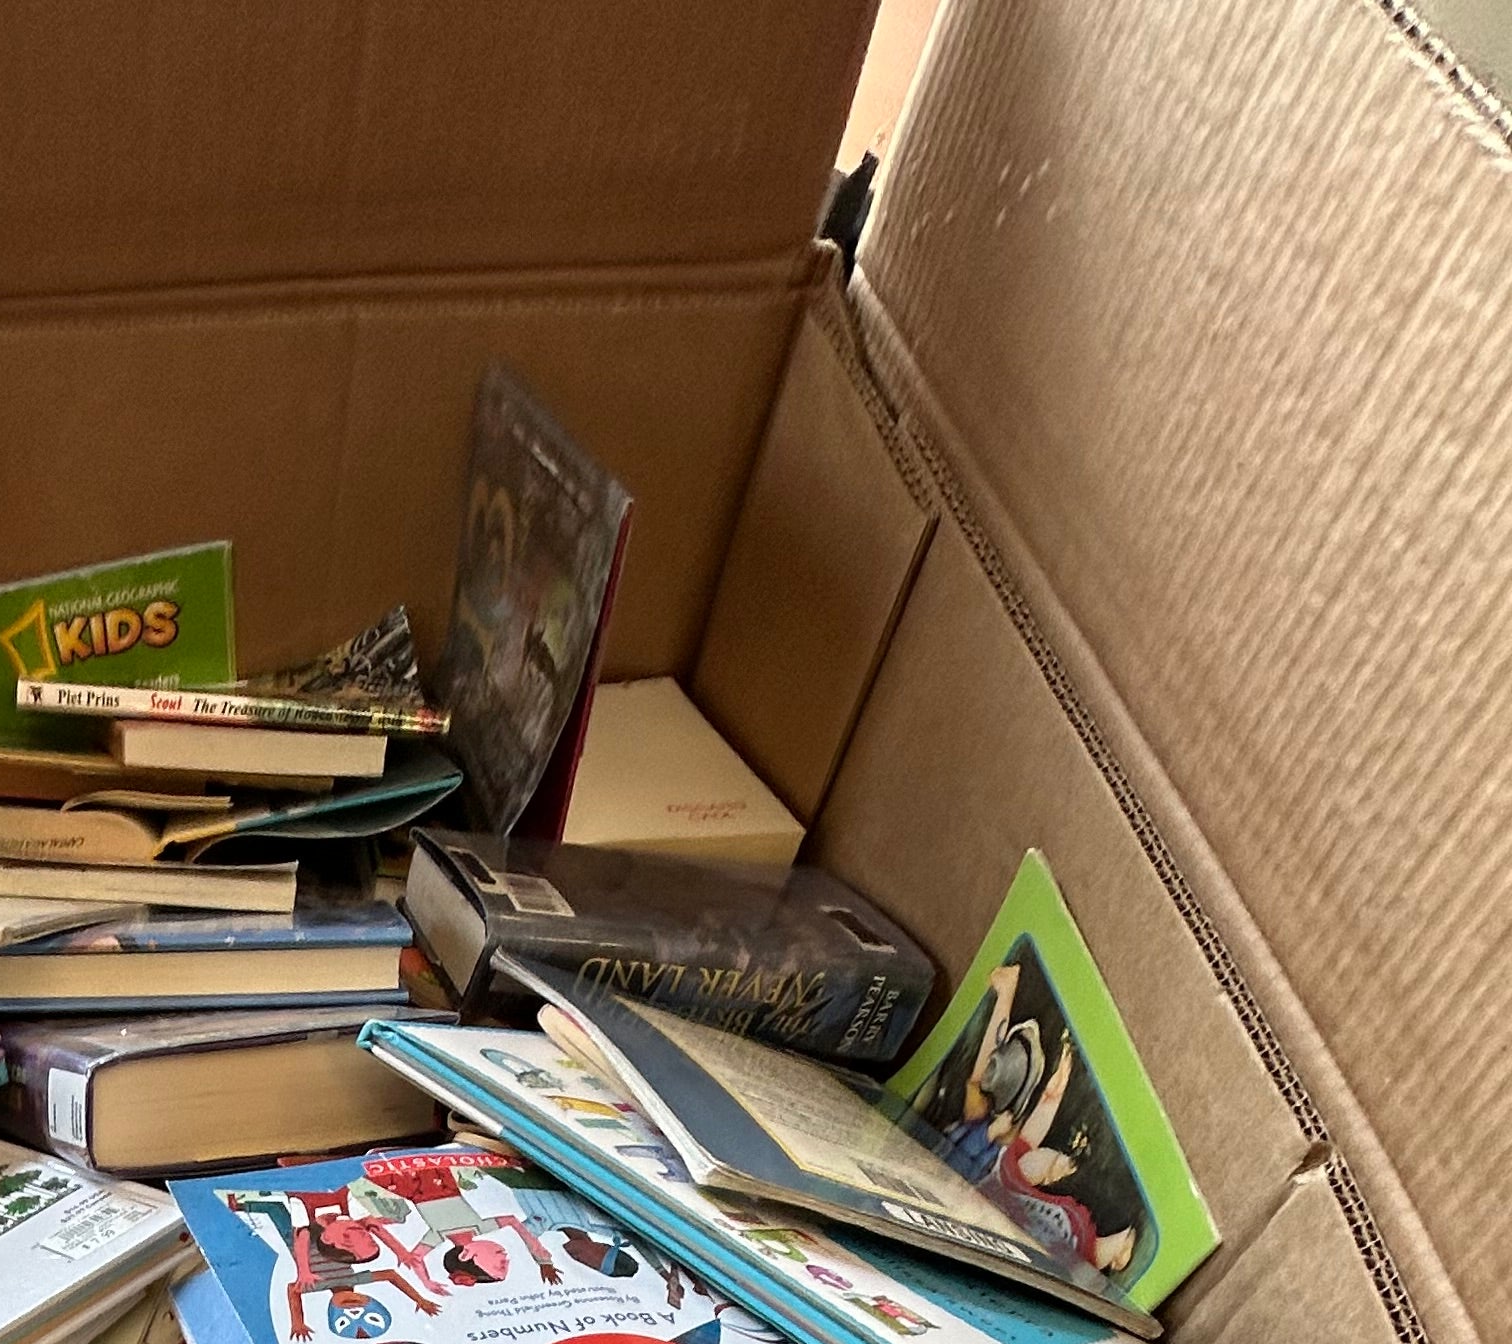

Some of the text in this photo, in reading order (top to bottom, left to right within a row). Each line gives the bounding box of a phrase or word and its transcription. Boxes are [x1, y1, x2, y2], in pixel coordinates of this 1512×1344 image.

[48, 578, 179, 618] NATIONAL GEOGRAPHIC
[53, 600, 180, 666] KIDS
[86, 691, 119, 706] Prins
[151, 693, 182, 710] Scout
[193, 698, 216, 713] The
[221, 700, 276, 720] Treasure
[694, 957, 824, 1015] NEVER
[367, 1152, 521, 1175] CHOLASTIC
[466, 1309, 675, 1343] A Book of Numbers
